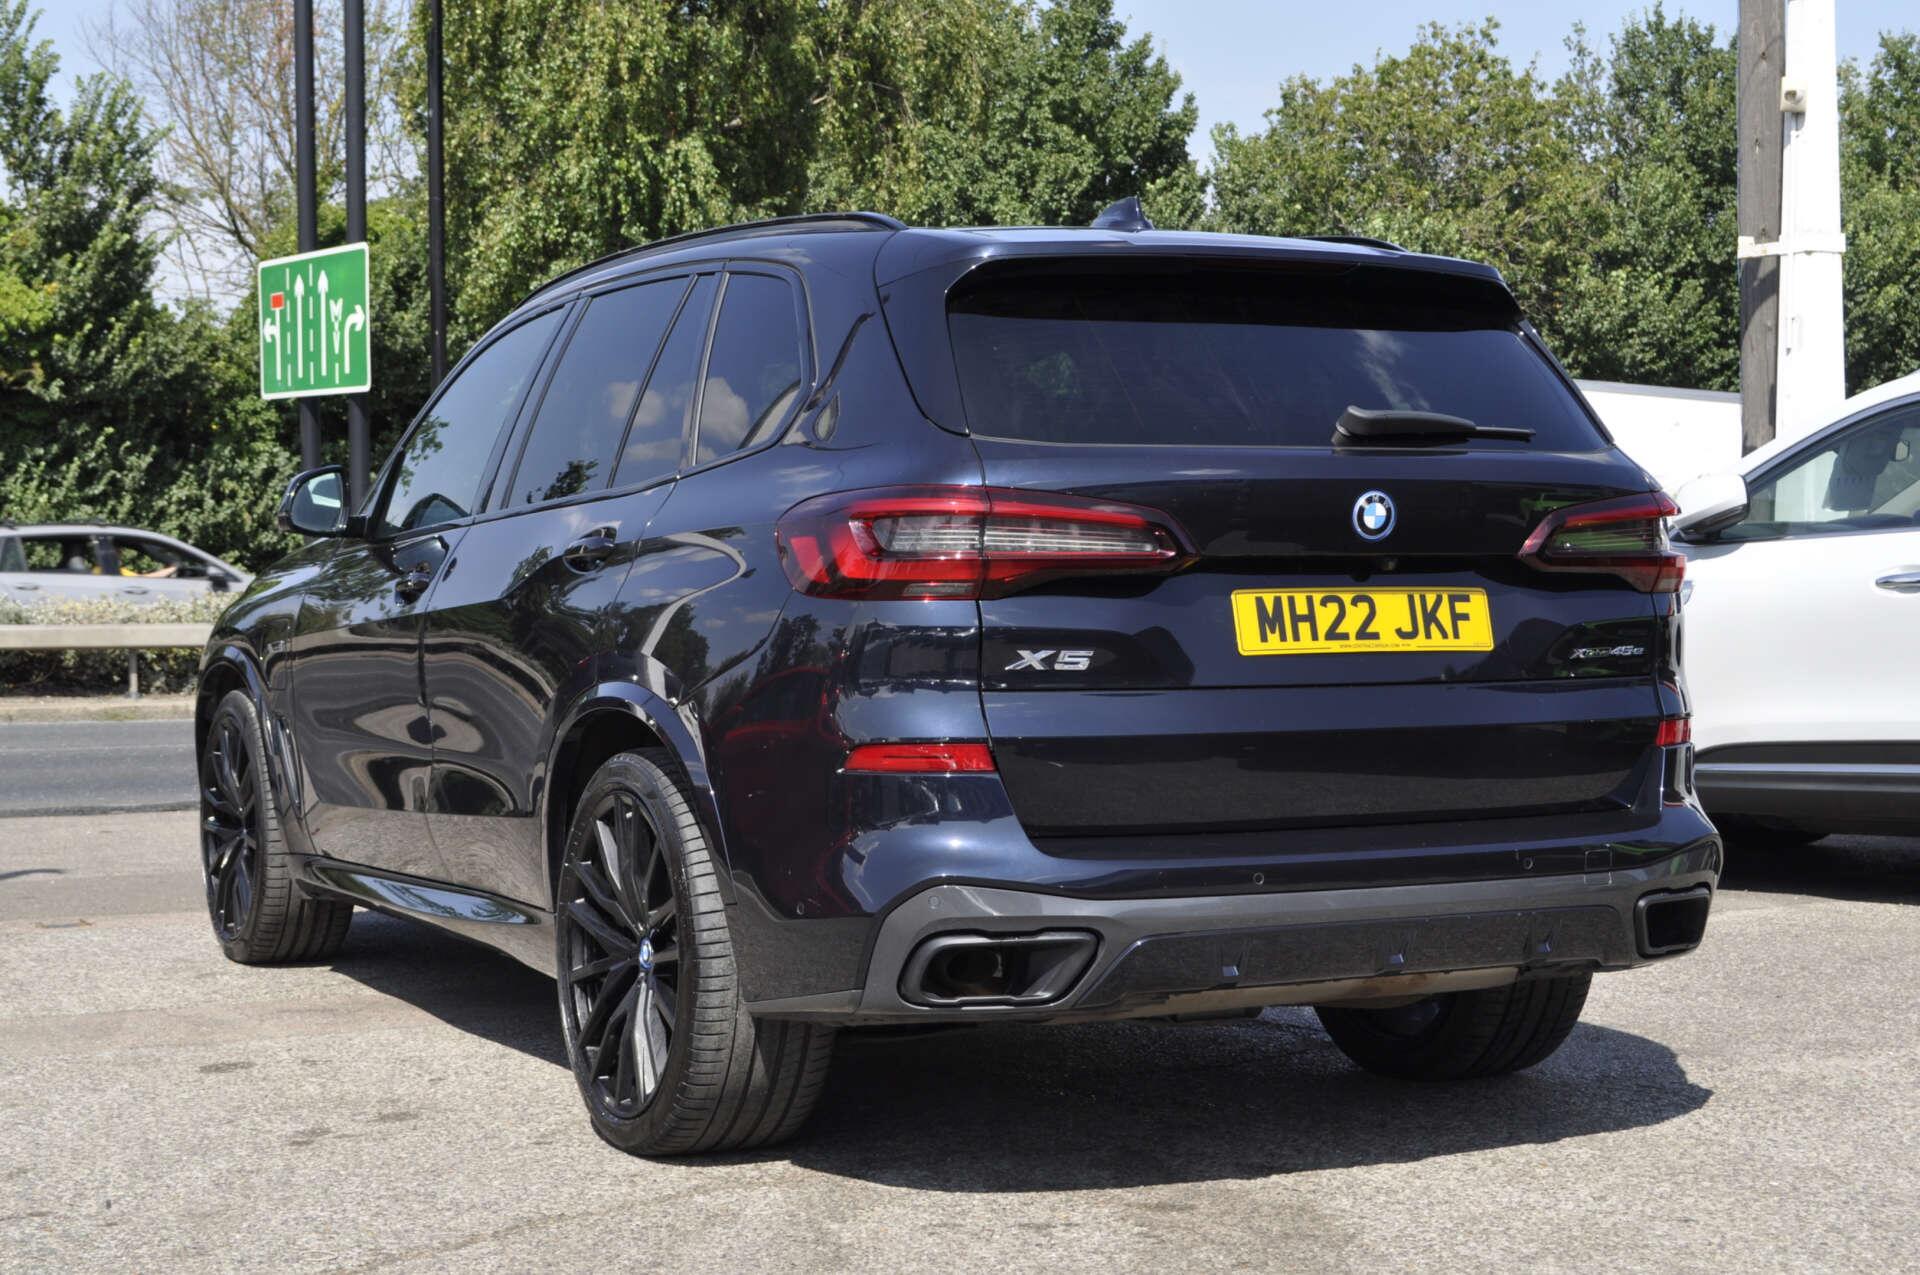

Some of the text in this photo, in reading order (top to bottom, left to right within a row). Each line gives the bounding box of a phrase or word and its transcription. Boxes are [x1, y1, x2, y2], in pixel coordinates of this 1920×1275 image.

[1255, 593, 1471, 643] MH22 JKF
[1005, 650, 1094, 671] X5
